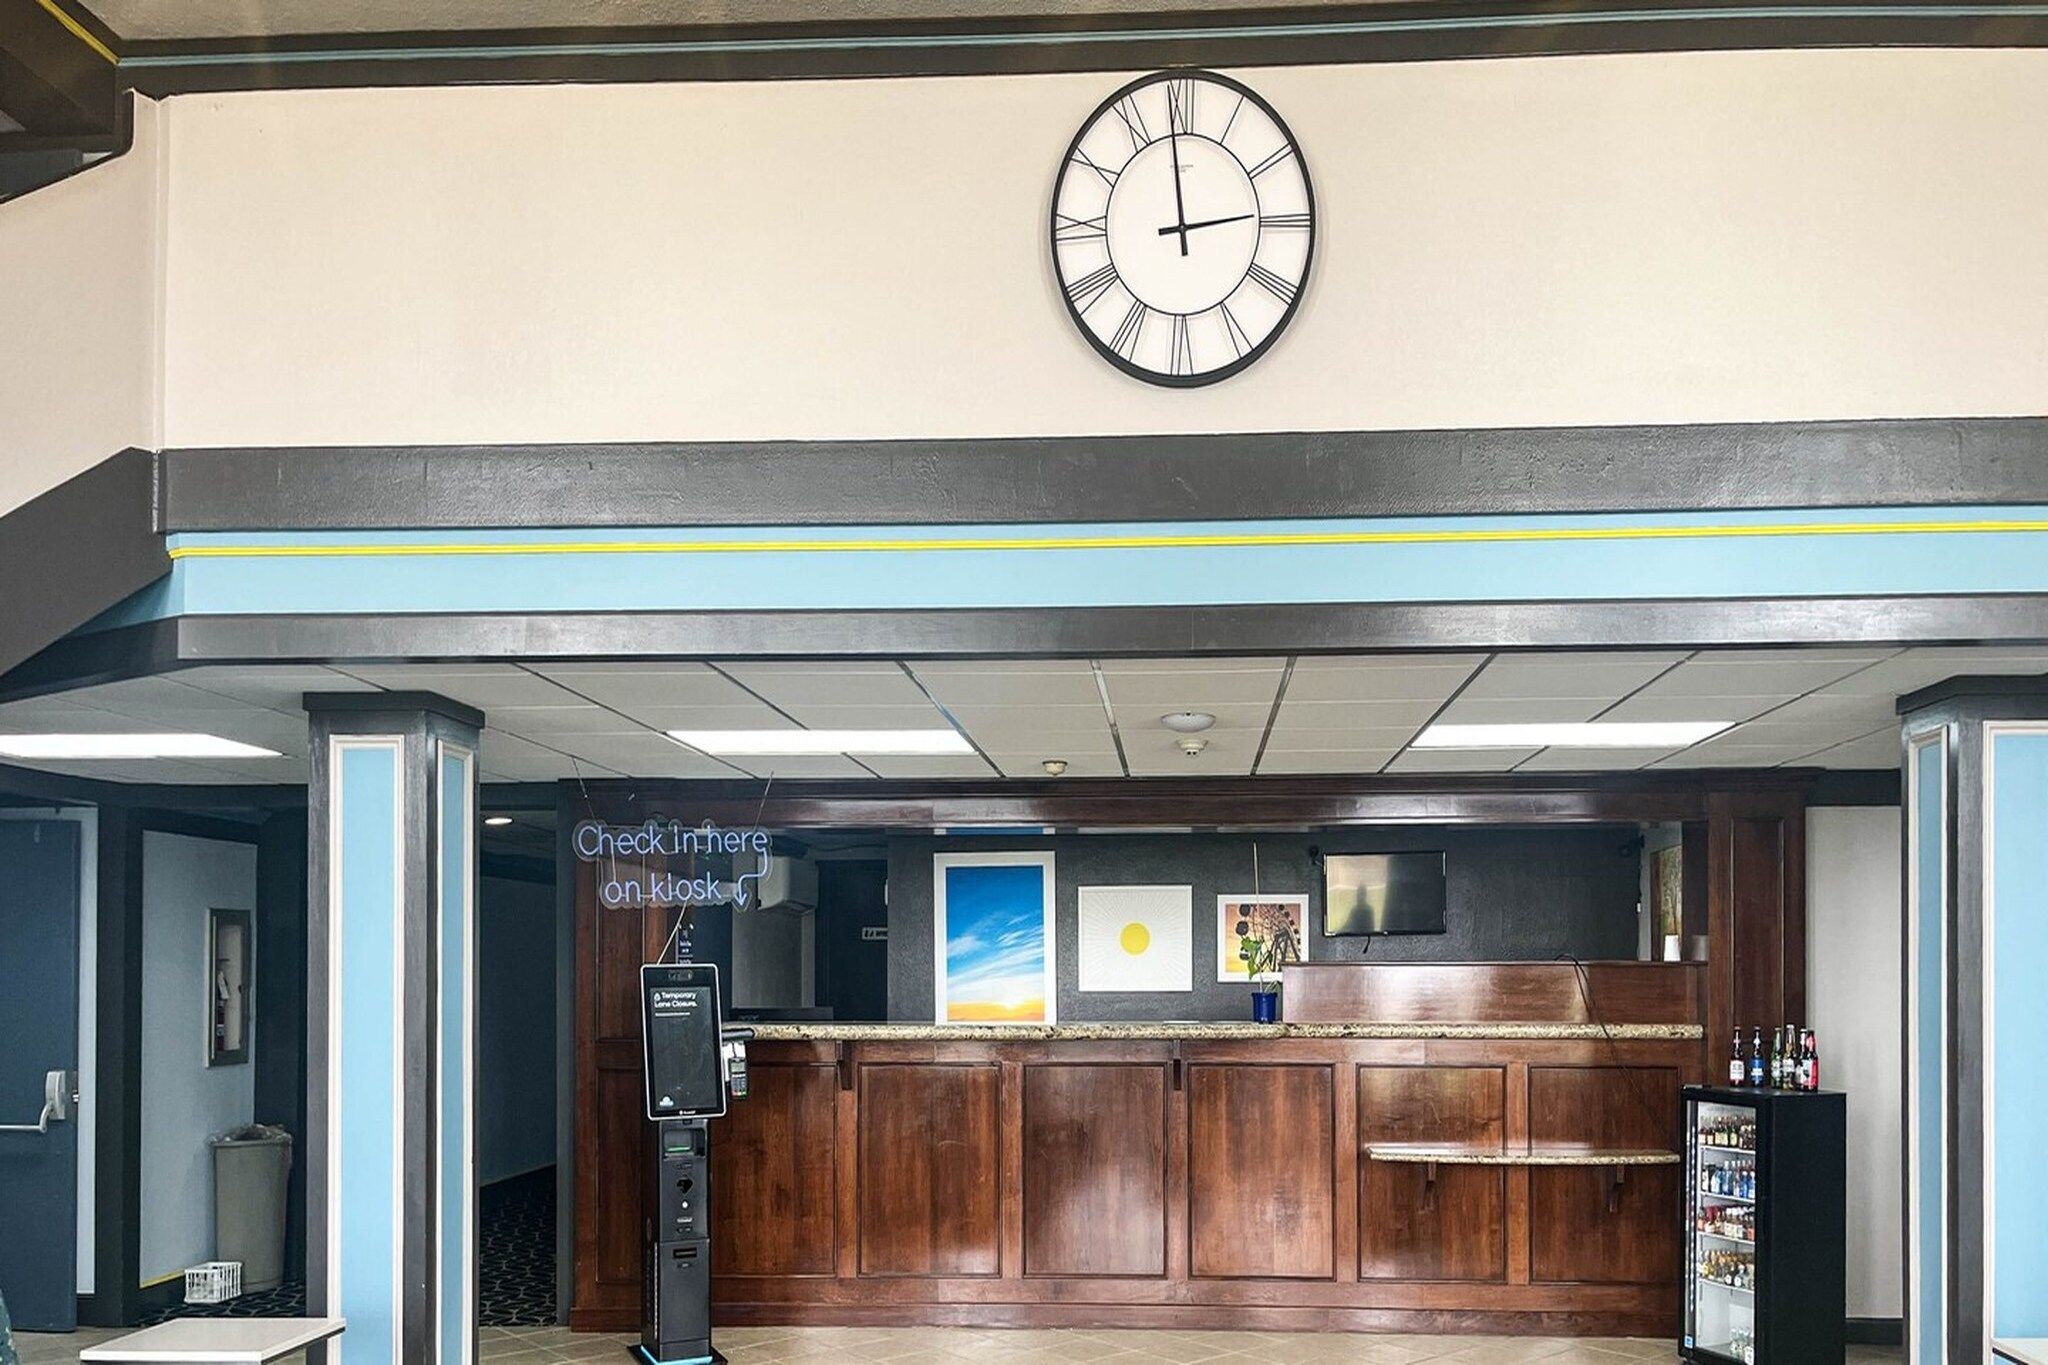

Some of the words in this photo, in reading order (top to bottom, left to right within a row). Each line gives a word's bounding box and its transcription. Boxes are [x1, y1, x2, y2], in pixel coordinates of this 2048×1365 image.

[1112, 94, 1151, 152] XI
[1169, 79, 1194, 134] XII
[1070, 147, 1119, 188] X
[1248, 144, 1295, 179] II
[1056, 213, 1107, 241] IX
[1259, 213, 1311, 227] III
[1109, 300, 1147, 362] VII
[1170, 314, 1193, 376] VI
[1220, 301, 1255, 358] V
[578, 825, 665, 856] Check
[707, 825, 768, 854] here
[604, 880, 641, 903] on
[650, 871, 722, 902] kiosk
[661, 992, 697, 1000] Temporary
